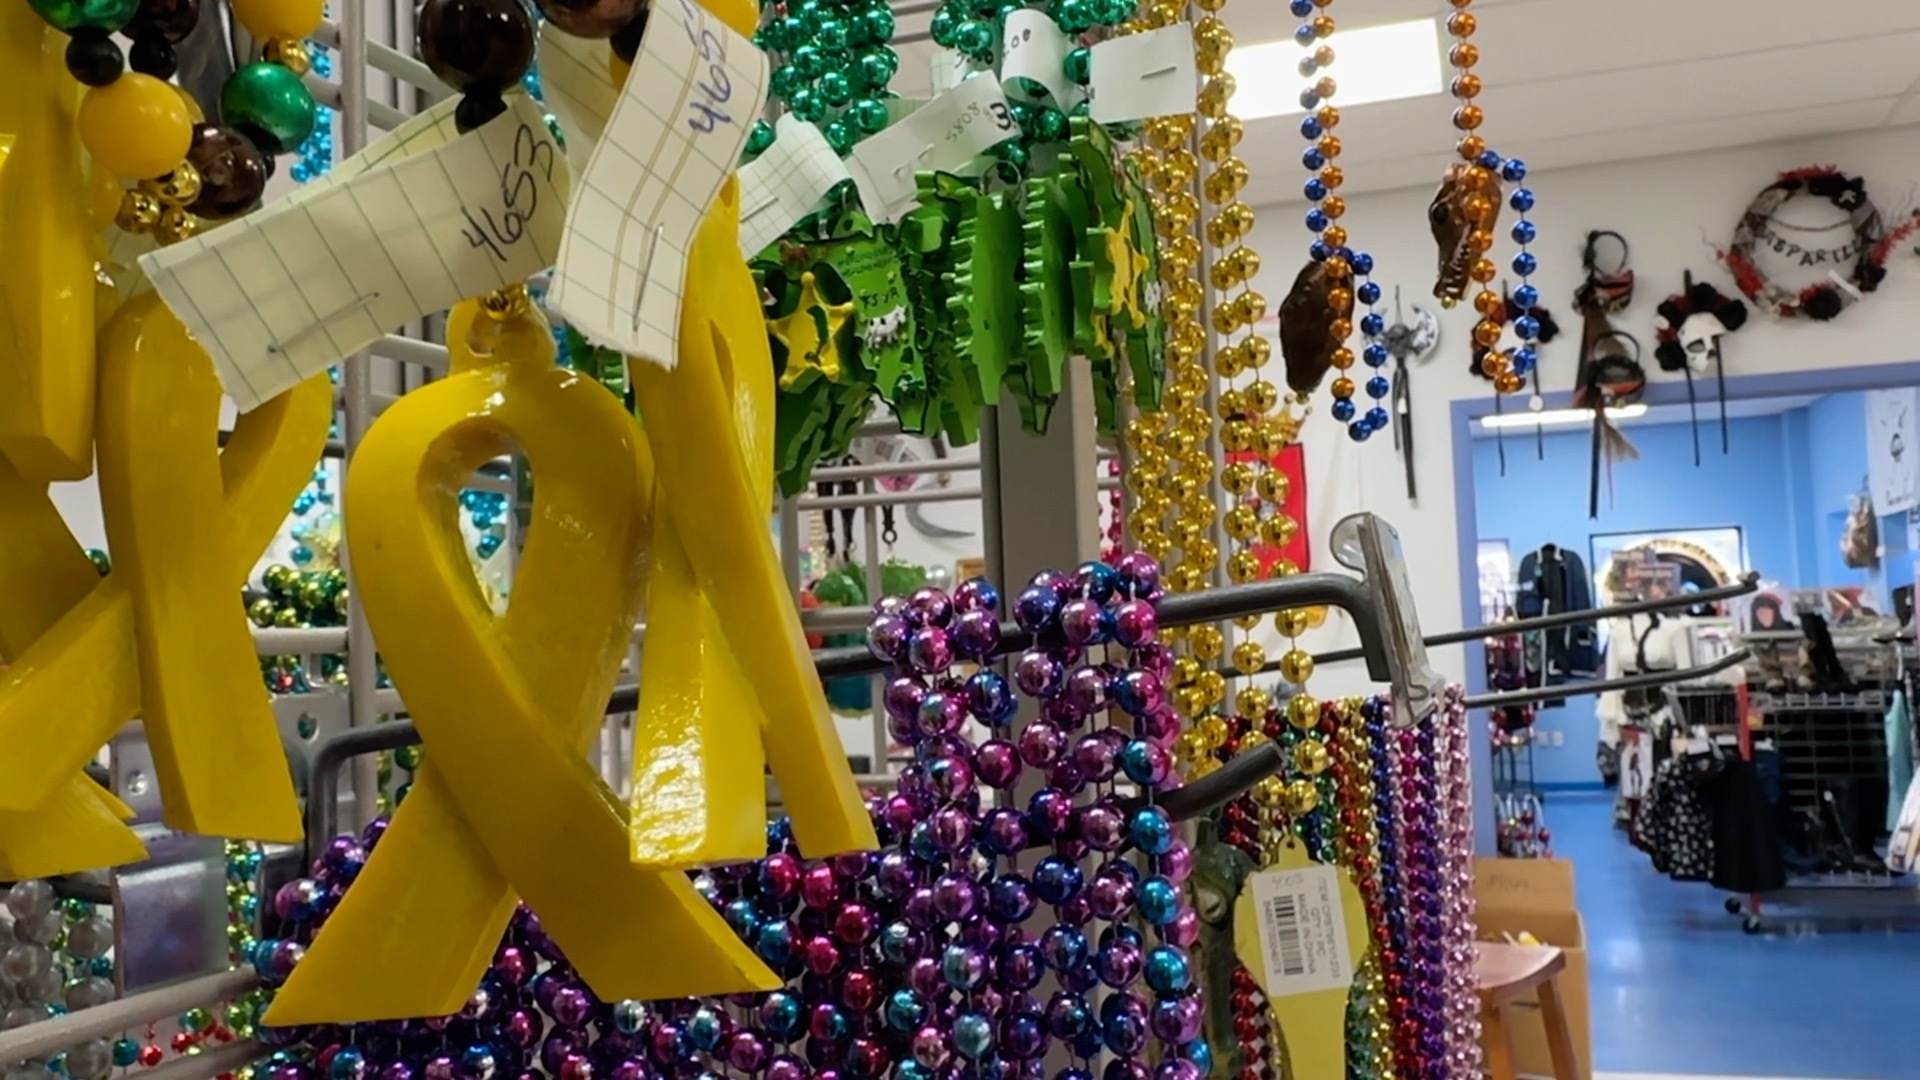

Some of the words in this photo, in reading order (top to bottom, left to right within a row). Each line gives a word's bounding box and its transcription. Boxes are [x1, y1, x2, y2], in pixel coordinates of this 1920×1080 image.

[681, 0, 732, 135] 465
[460, 123, 554, 262] 4653
[1297, 893, 1310, 923] MADE
[1302, 927, 1311, 939] IN
[1303, 940, 1317, 975] CHINA
